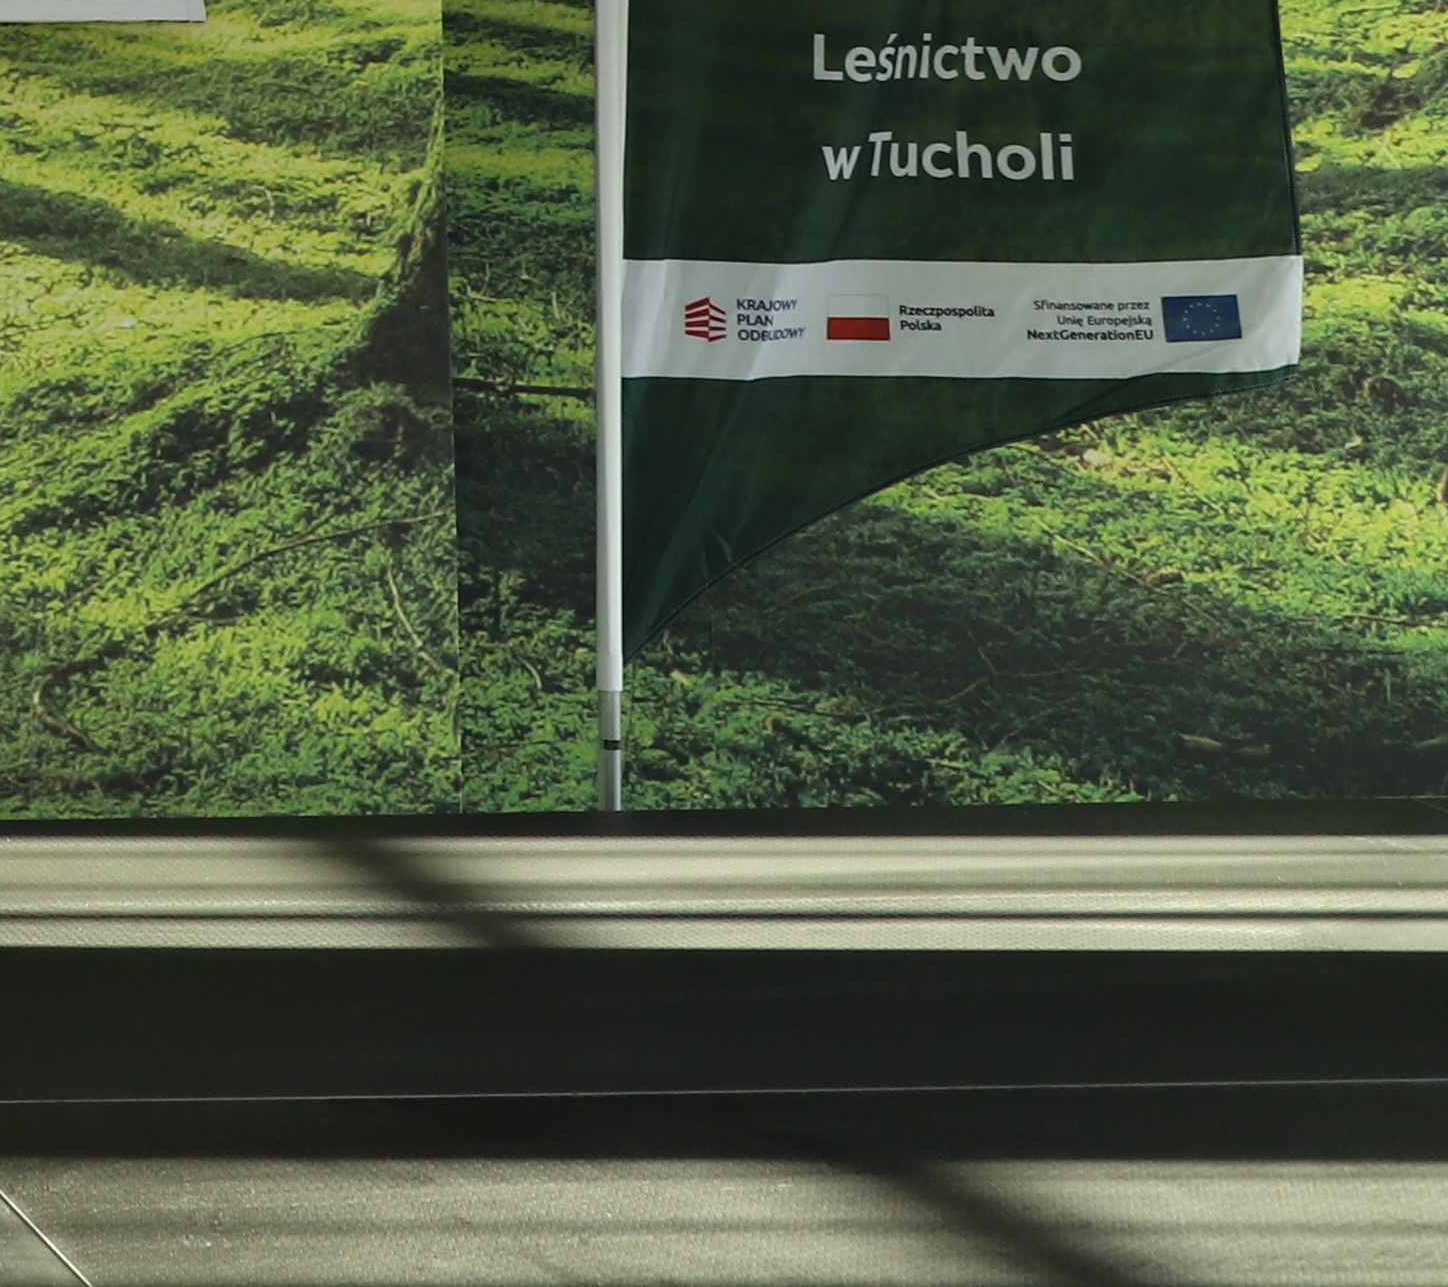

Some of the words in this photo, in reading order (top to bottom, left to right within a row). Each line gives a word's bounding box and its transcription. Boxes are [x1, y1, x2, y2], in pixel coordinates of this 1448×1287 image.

[813, 33, 1083, 83] Leśnictwo
[822, 144, 862, 180] w
[868, 130, 1074, 181] Tucholi
[737, 299, 799, 311] KRAJOWY
[899, 305, 994, 318] Rzeczpospolita
[1033, 300, 1115, 311] Sfinansowane
[1118, 301, 1150, 313] przez
[737, 314, 774, 326] PLAN
[900, 319, 942, 331] Polska
[1057, 315, 1083, 327] Unię
[1087, 315, 1152, 327] Europejską
[738, 327, 806, 342] ODBUDOWY
[1027, 329, 1154, 342] NextGenerationEU
